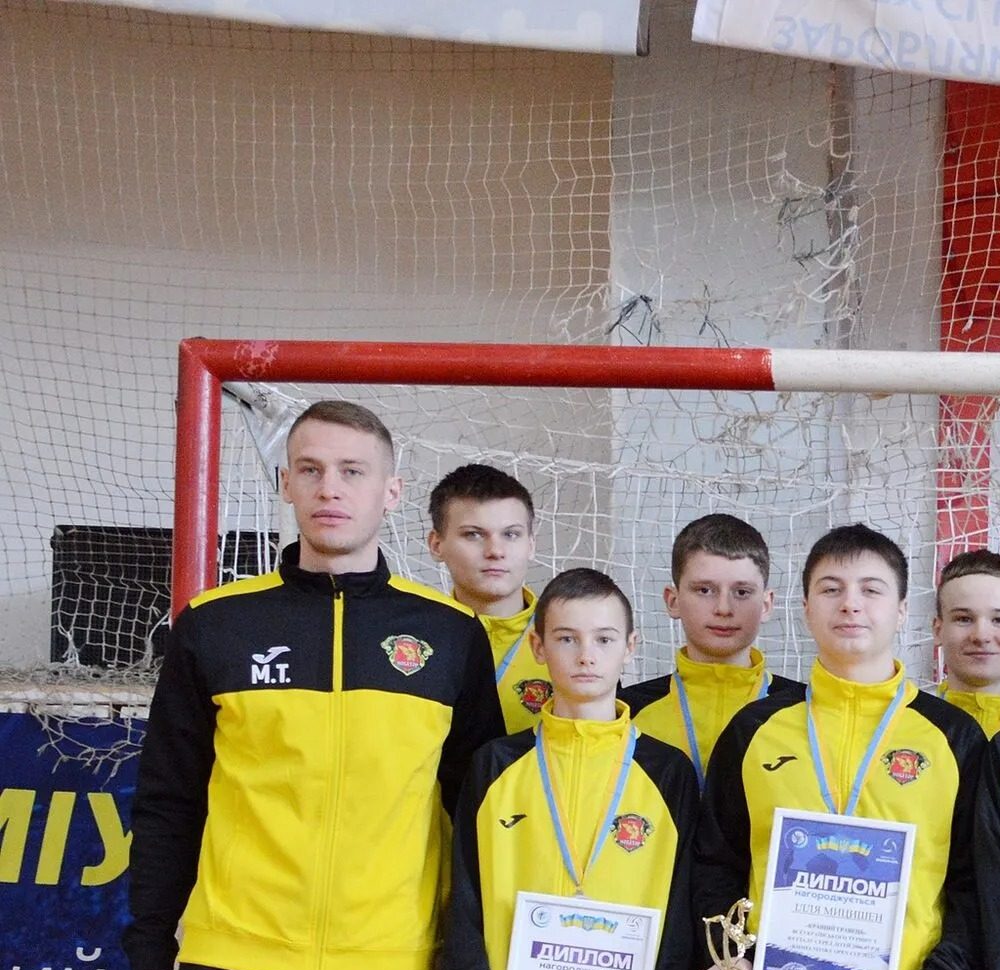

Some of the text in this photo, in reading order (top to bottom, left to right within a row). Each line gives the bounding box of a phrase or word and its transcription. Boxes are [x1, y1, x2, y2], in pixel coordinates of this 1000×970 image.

[251, 663, 291, 684] M.T.
[792, 871, 887, 898] ДИПЛОМ
[794, 890, 876, 906] нагороджується
[536, 943, 632, 970] ДИПЛОМ
